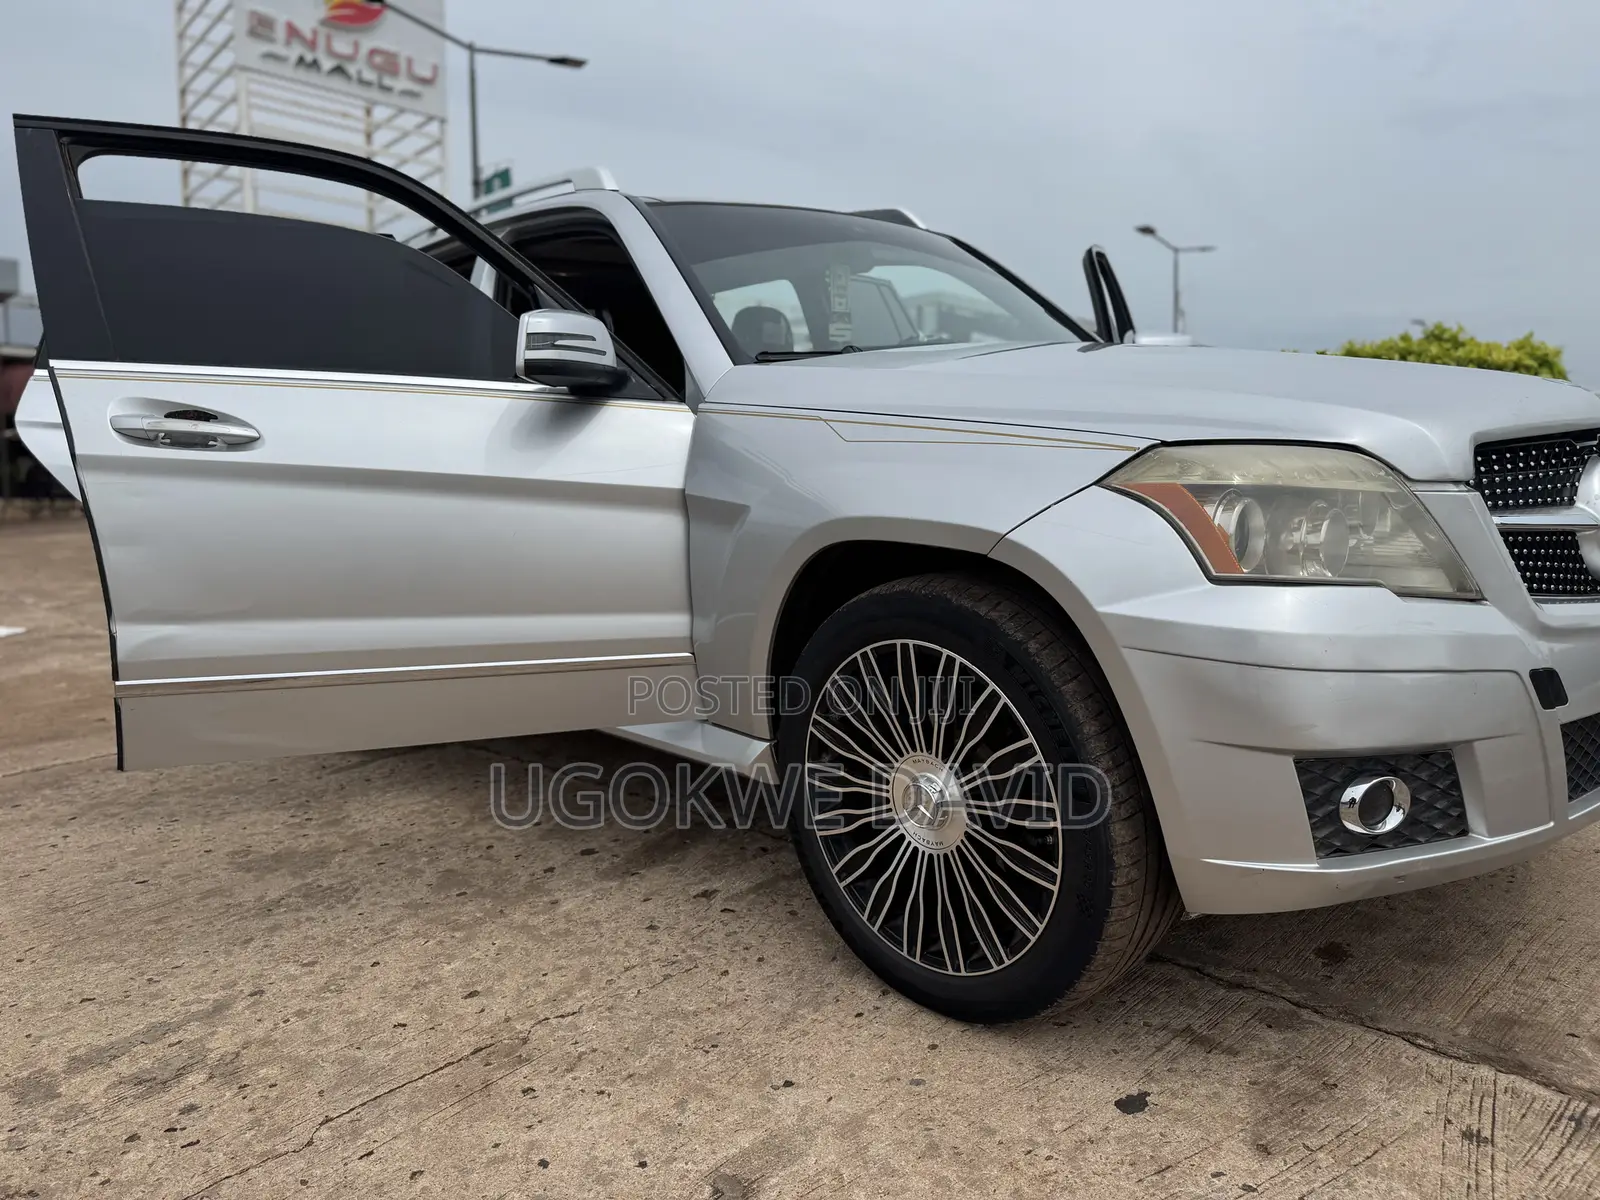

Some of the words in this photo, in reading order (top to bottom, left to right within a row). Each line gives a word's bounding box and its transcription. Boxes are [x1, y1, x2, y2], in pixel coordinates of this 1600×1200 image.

[247, 10, 439, 85] ENUGU
[295, 56, 393, 92] MALL
[912, 758, 944, 771] MAYBACH
[912, 830, 944, 846] MAYBACH
